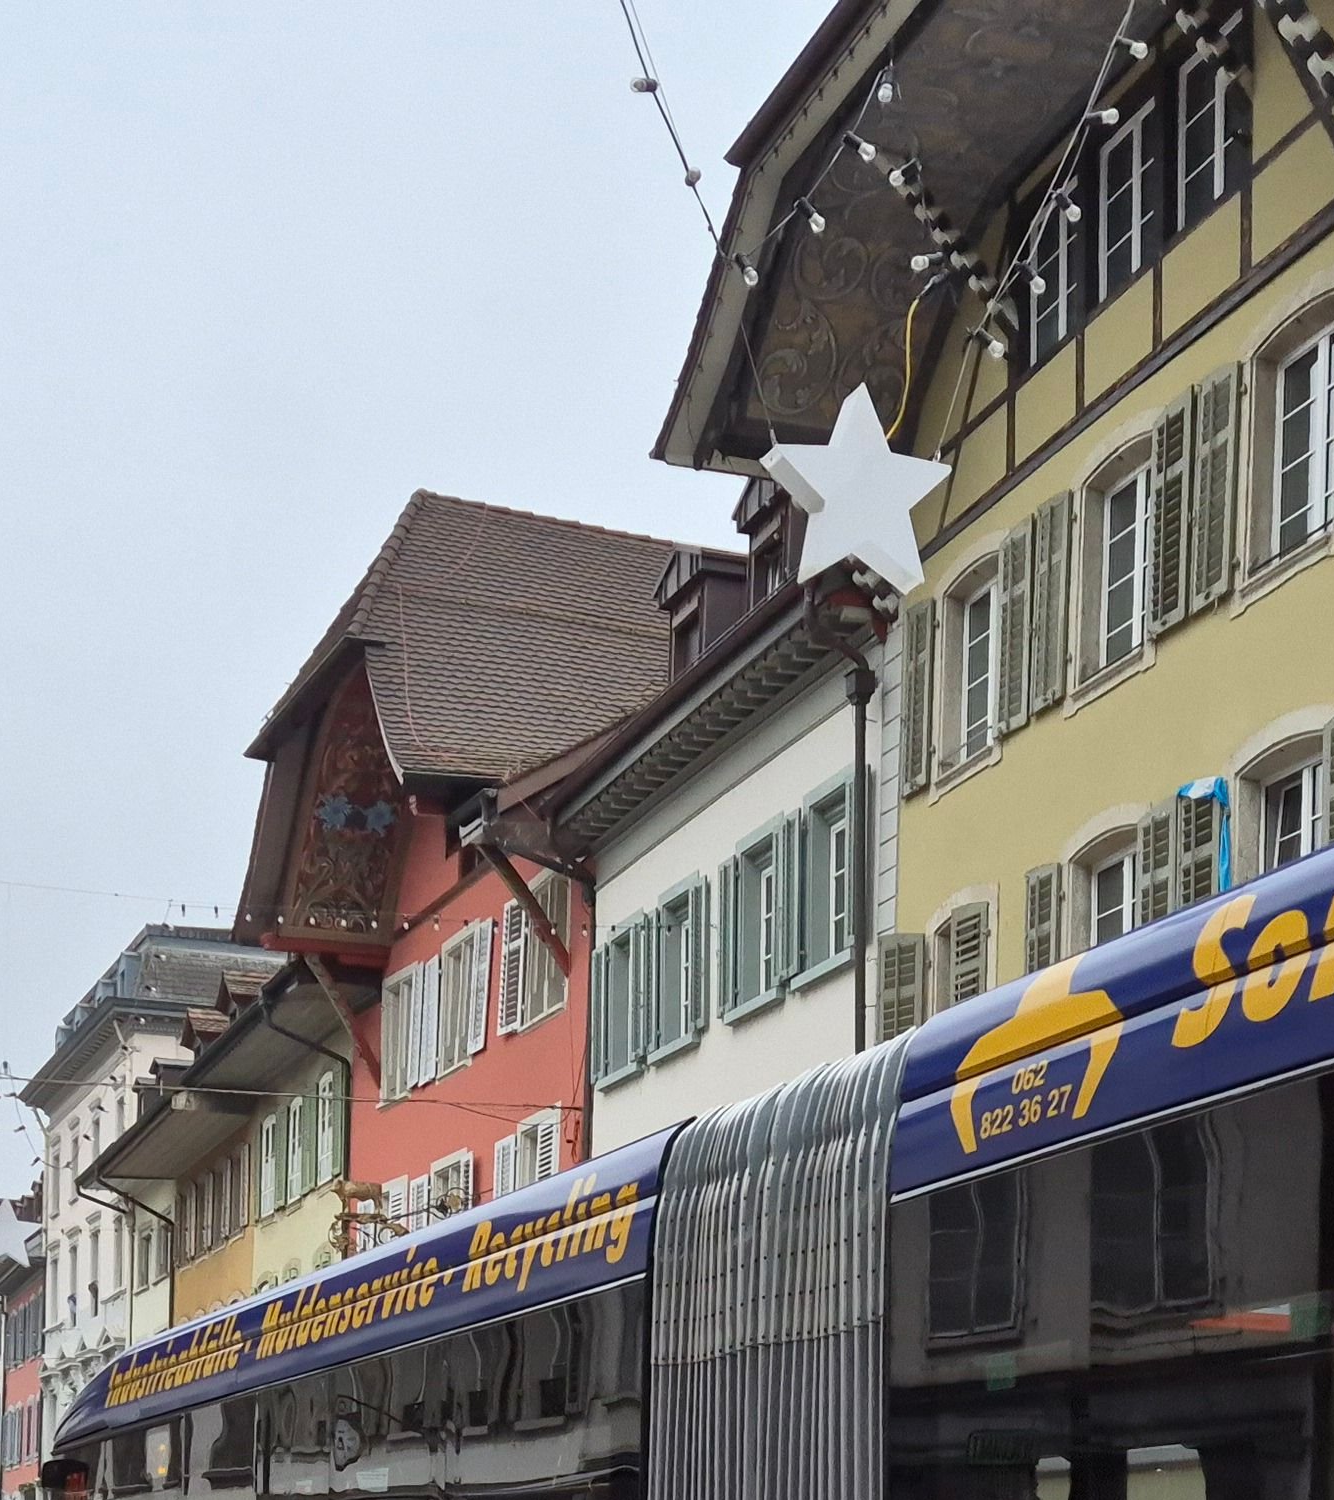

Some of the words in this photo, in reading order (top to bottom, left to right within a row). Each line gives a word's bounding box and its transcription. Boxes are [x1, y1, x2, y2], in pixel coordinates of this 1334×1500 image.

[1011, 1059, 1049, 1095] 062
[979, 1104, 1014, 1140] 822
[1018, 1094, 1042, 1128] 36
[1046, 1083, 1073, 1118] 27
[255, 1245, 440, 1360] Muldenservice
[461, 1172, 639, 1293] Recycling
